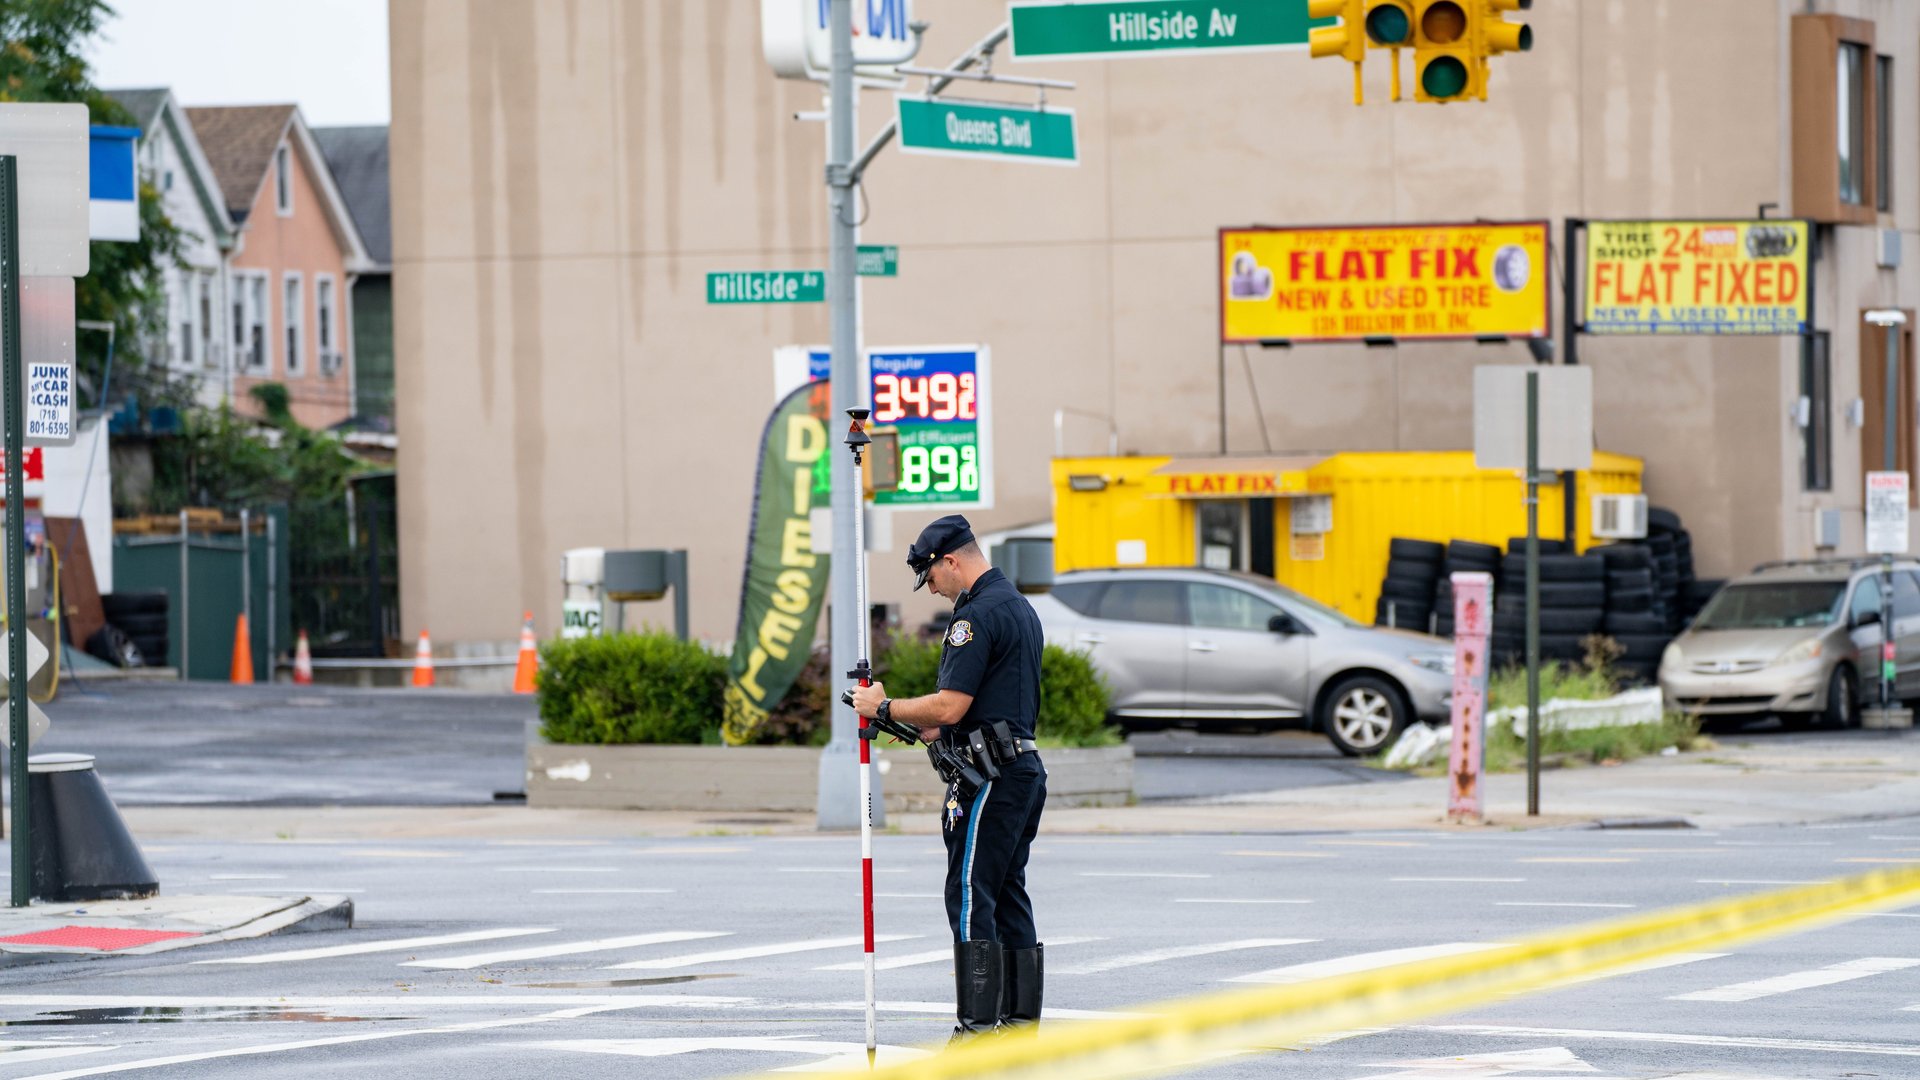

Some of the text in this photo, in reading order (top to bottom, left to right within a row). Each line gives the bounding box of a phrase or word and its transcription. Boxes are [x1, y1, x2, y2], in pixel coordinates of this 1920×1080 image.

[1109, 8, 1237, 42] Hillside Av
[945, 111, 1033, 149] Queens Blvd
[1603, 231, 1653, 244] TIRE
[1662, 226, 1704, 259] 24
[1596, 247, 1657, 260] SHOP
[1289, 247, 1480, 281] FLAT FIX
[714, 272, 798, 300] Hillside
[1594, 262, 1800, 305] FLAT FIXED
[1277, 284, 1491, 311] NEW & USED TIRE
[1594, 307, 1640, 321] NEW
[1671, 307, 1727, 321] USED
[1736, 306, 1798, 321] TIRES
[32, 366, 69, 378] JUNK
[872, 356, 925, 374] Regular
[31, 380, 68, 393] ANY CAR
[31, 393, 68, 408] 4 CA$H
[40, 409, 60, 421] (718)
[30, 421, 69, 435] 801-6395
[918, 429, 975, 445] Efficient
[1170, 475, 1275, 493] FLAT FIX
[739, 414, 827, 702] DIESEL
